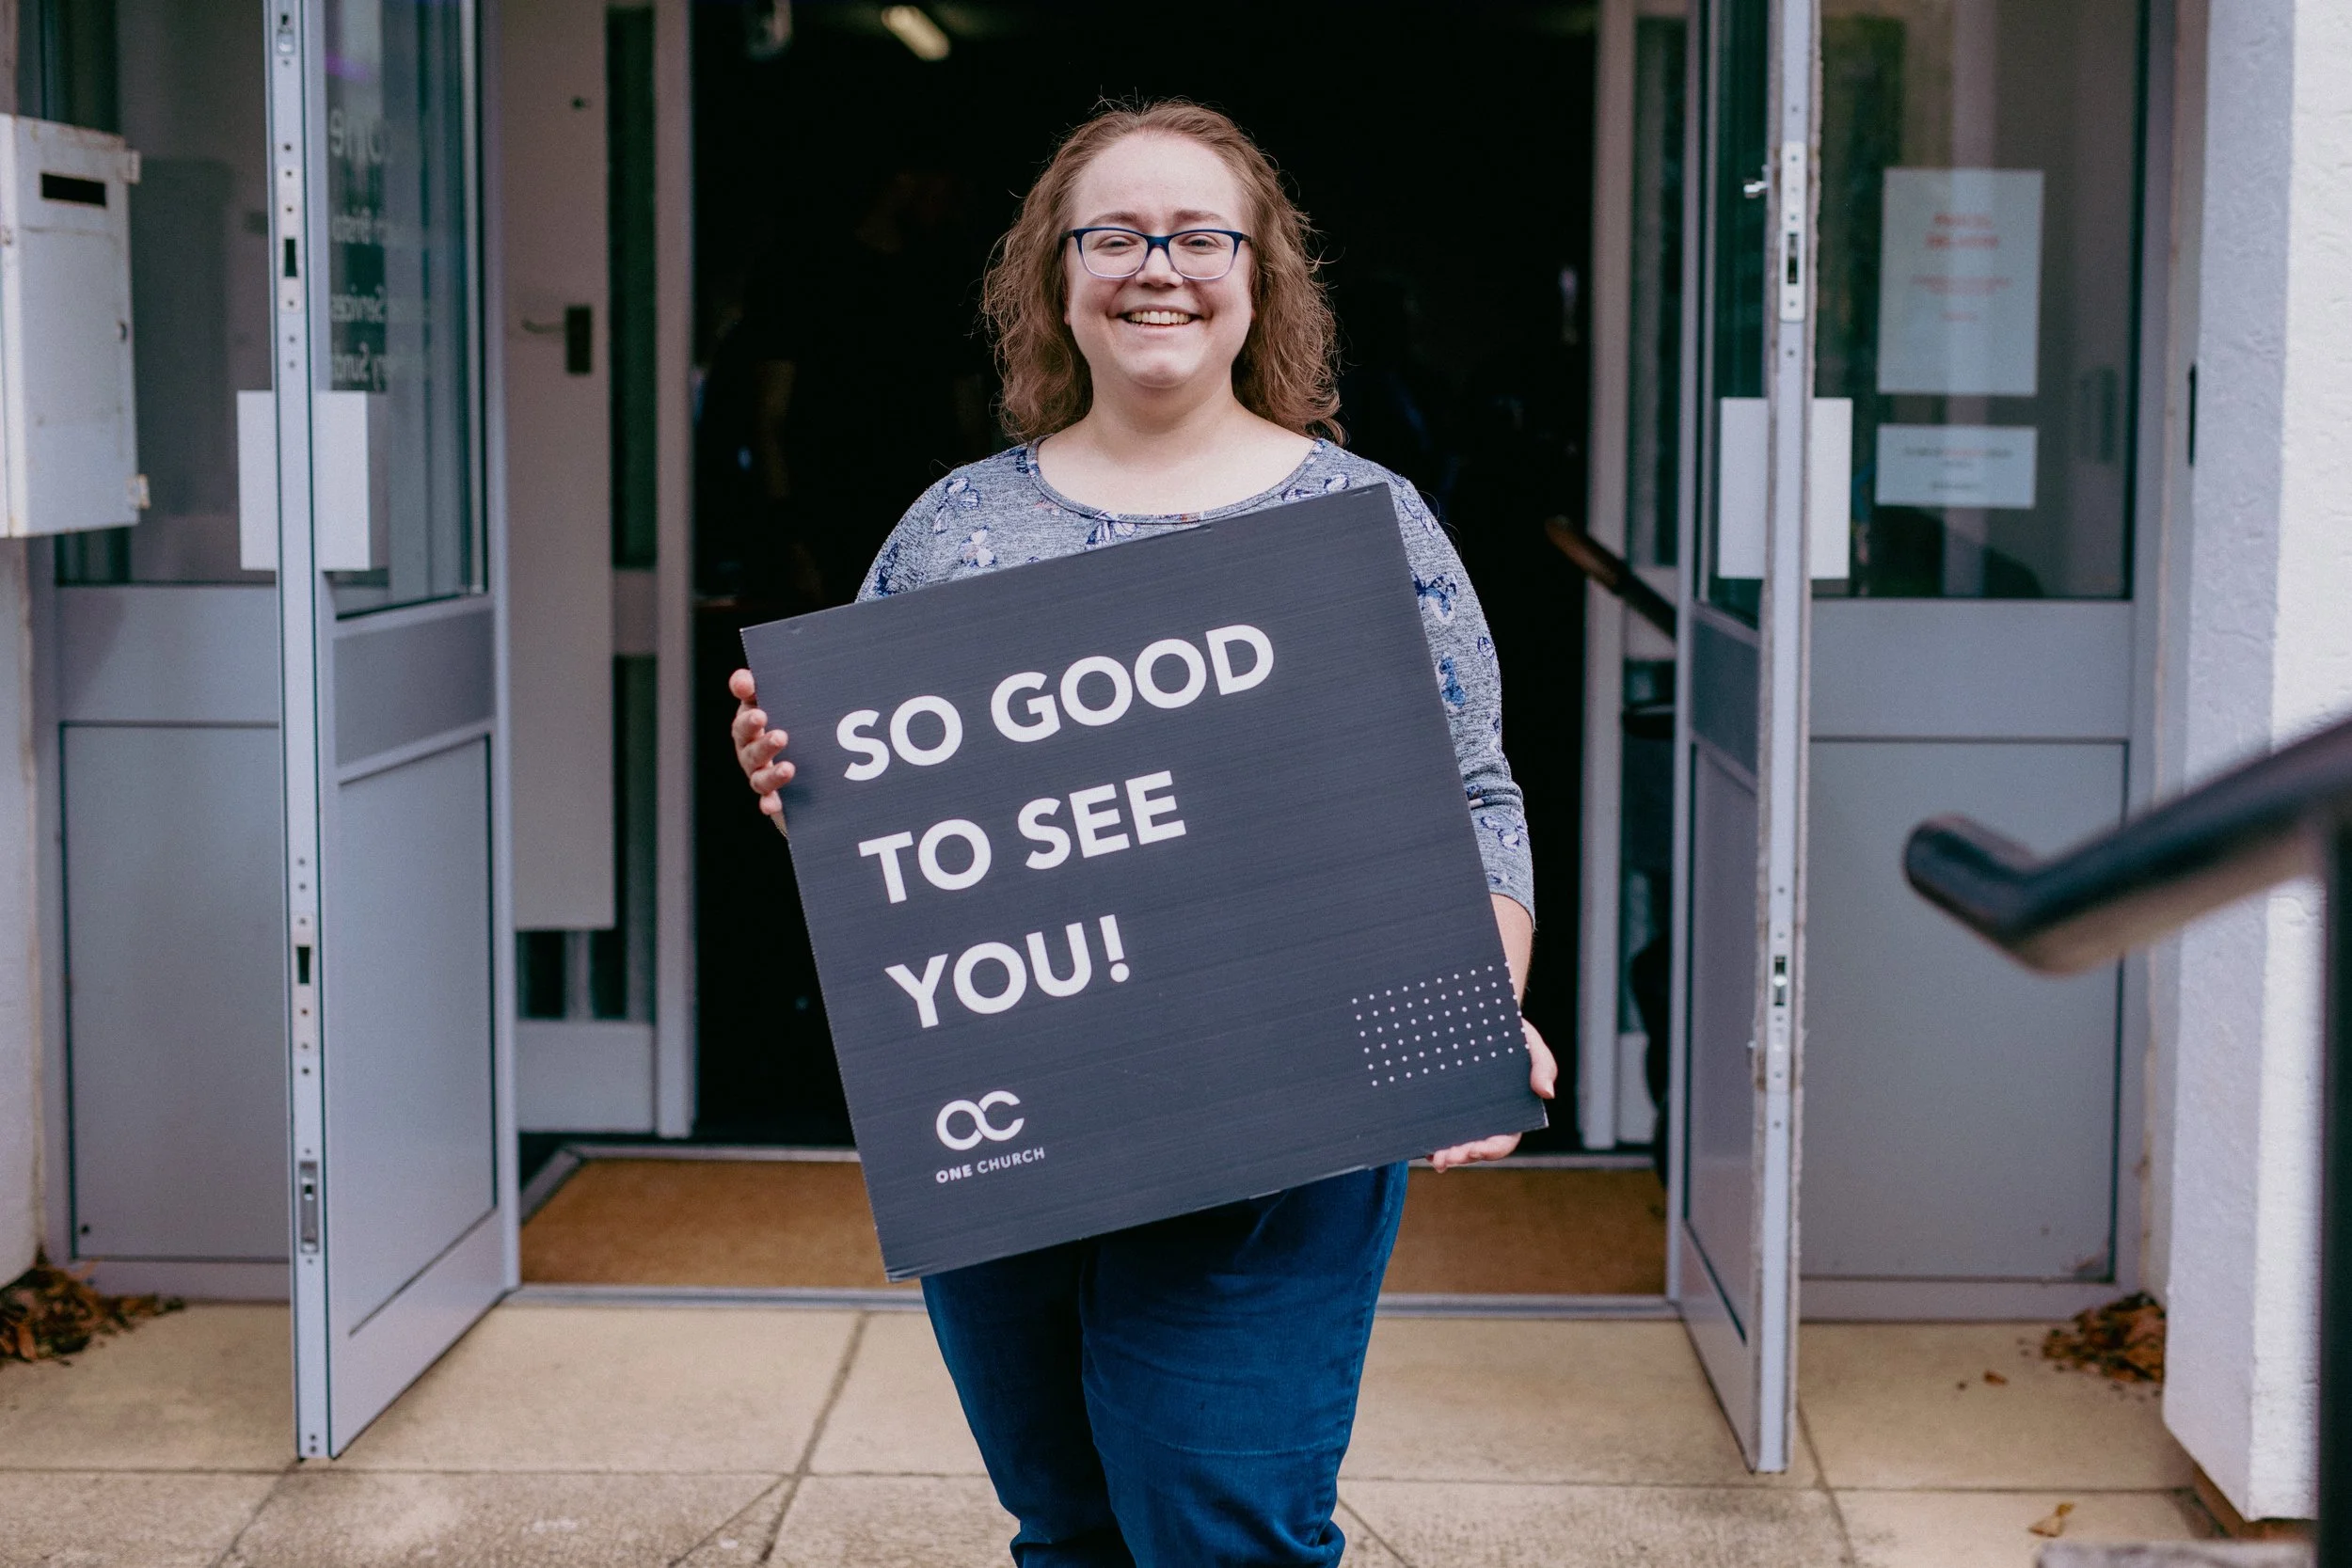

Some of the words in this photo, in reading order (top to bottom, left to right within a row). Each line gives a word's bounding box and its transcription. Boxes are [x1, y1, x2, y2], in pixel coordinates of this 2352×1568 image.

[836, 695, 963, 782] SO
[990, 624, 1275, 743] GOOD
[858, 818, 992, 904] TO
[1017, 769, 1187, 870] SEE
[884, 913, 1131, 1029] YOU!
[935, 1164, 973, 1183] ONE
[977, 1147, 1045, 1174] CHURCH
